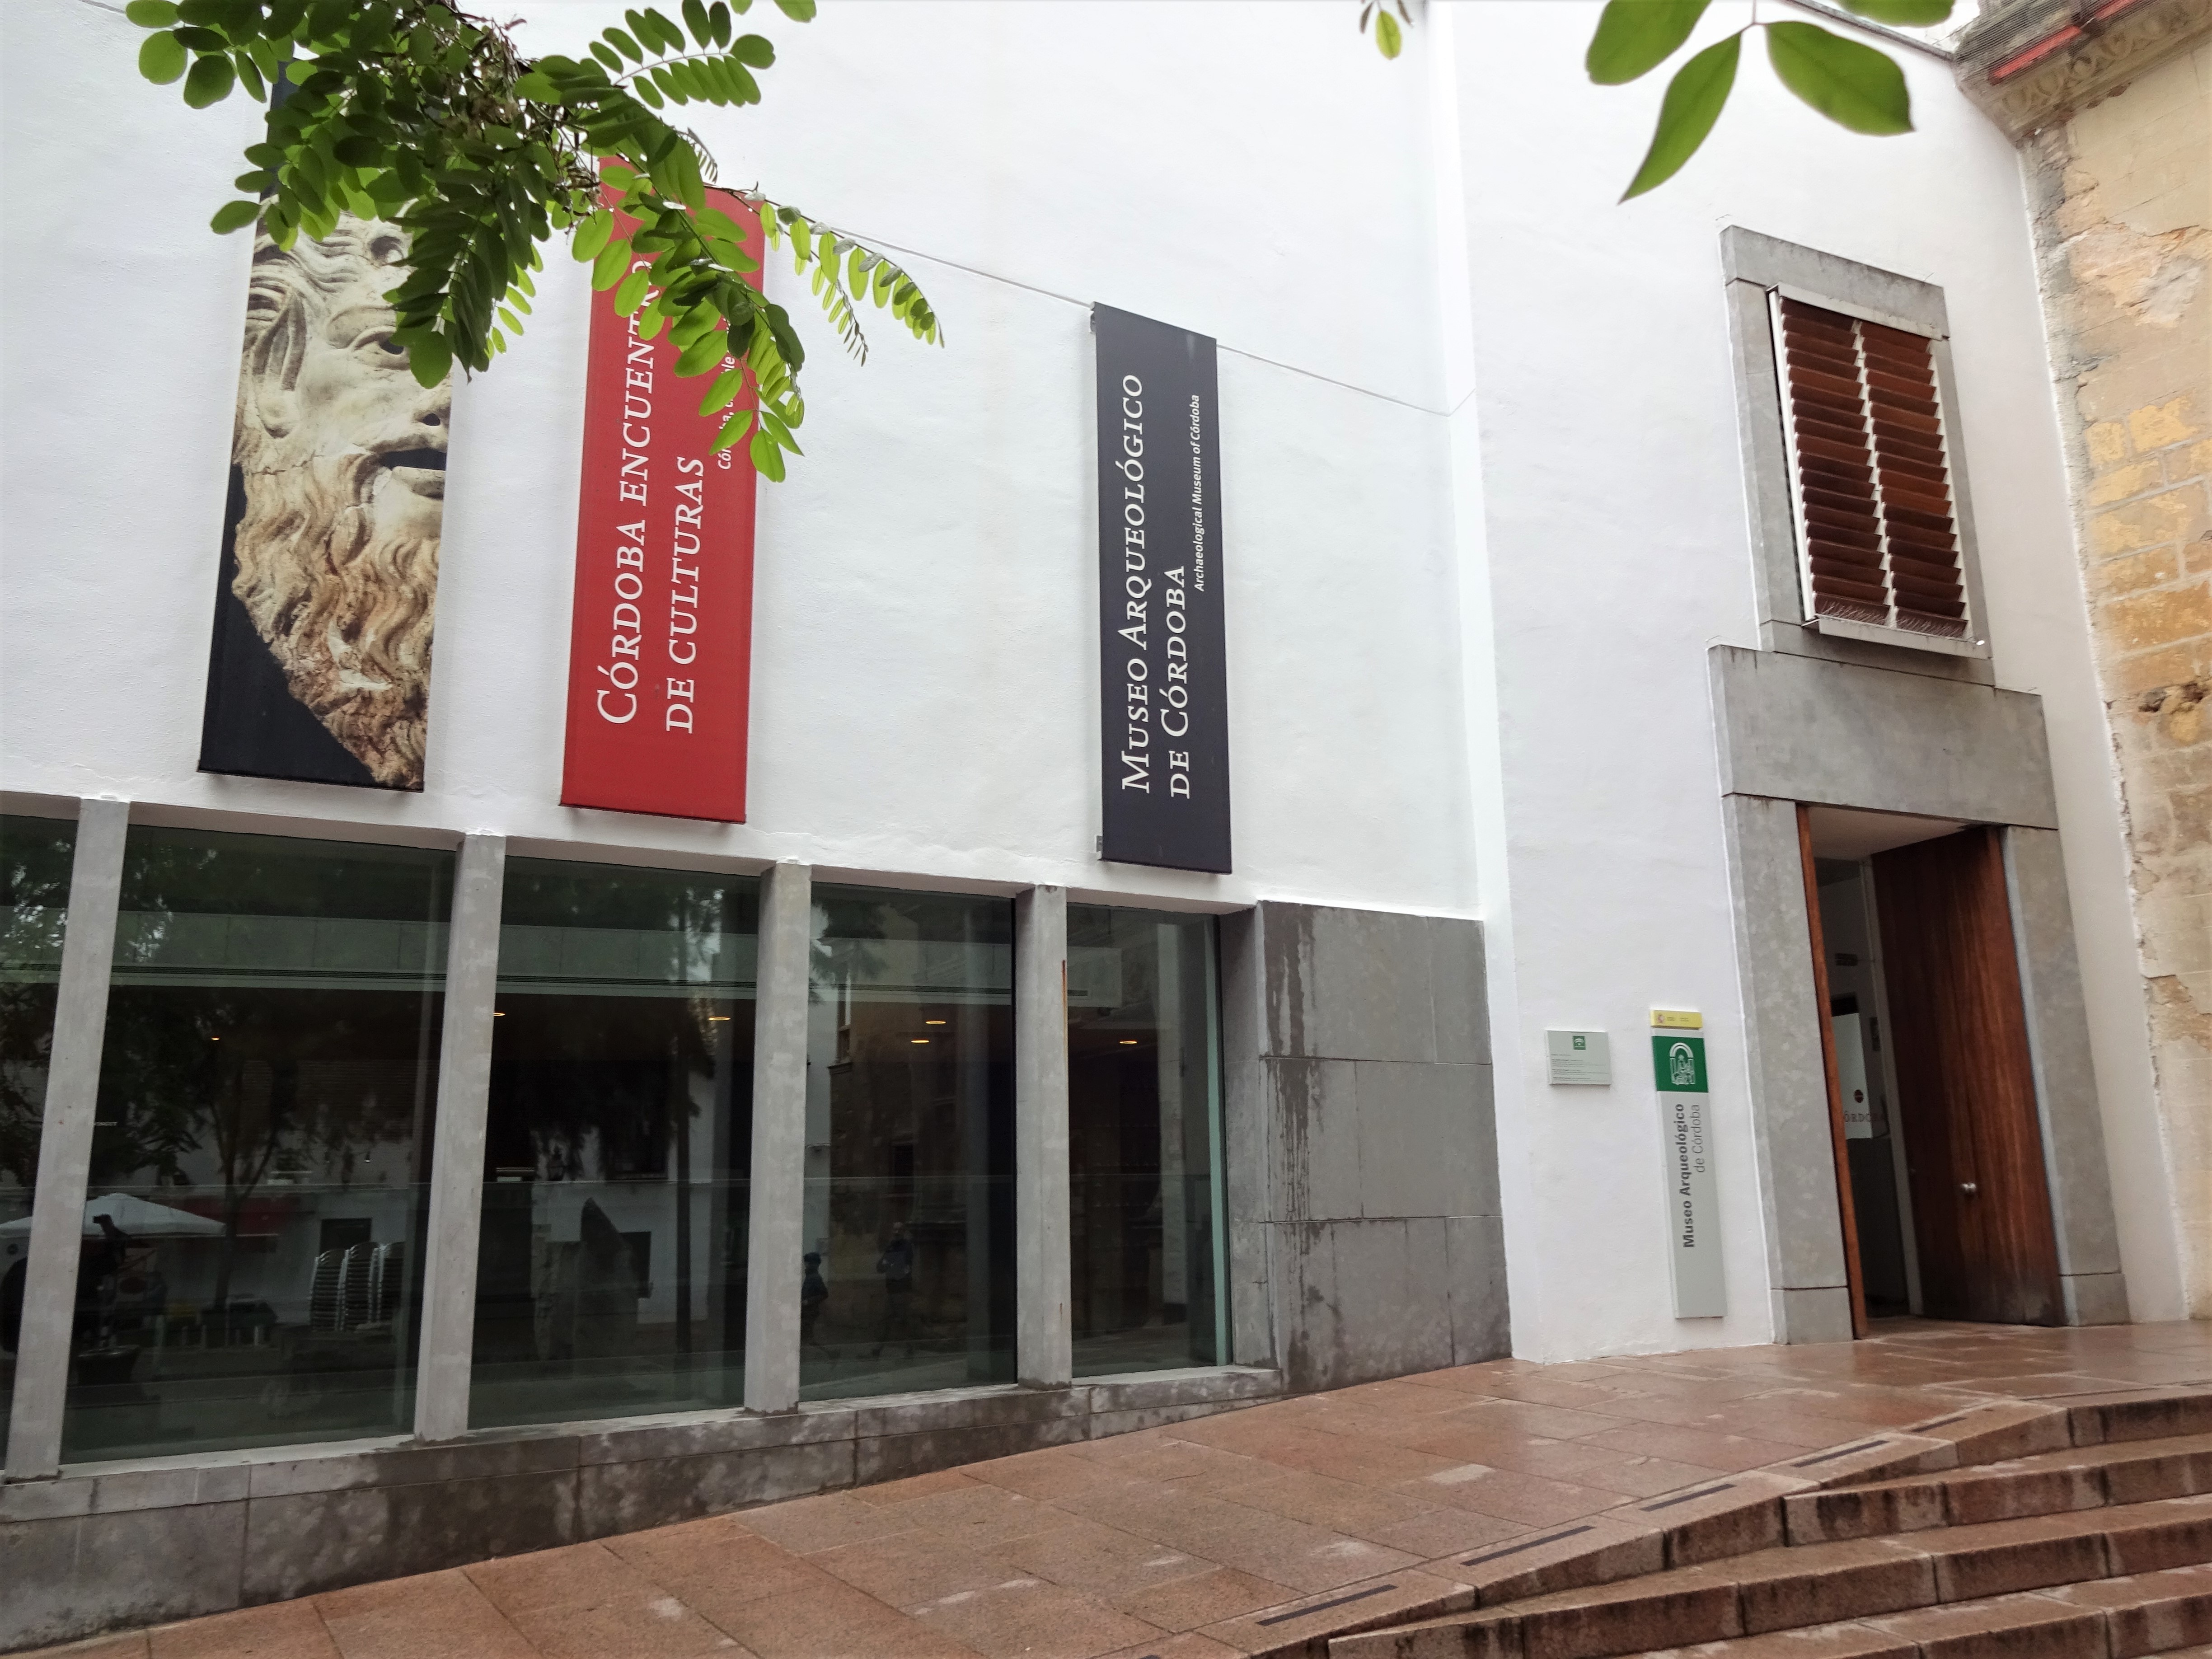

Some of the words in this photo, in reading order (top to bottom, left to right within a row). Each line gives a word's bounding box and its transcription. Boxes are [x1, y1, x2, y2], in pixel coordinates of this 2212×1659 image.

[1187, 394, 1200, 441] Córdoba
[1190, 441, 1200, 455] of
[1190, 455, 1202, 505] Museum
[1115, 375, 1152, 651] ARQUEOLÓGICO
[669, 456, 704, 665] CULTURAS
[1191, 507, 1205, 592] Archaeological
[597, 520, 646, 724] CÓRDOBA
[1159, 566, 1189, 737] CÓRDOBA
[665, 678, 695, 734] DE
[1121, 658, 1150, 794] MUSEO
[1169, 750, 1190, 799] DE
[1673, 1104, 1692, 1196] Arqueológico
[1690, 1105, 1703, 1154] Córdoba
[1693, 1158, 1705, 1173] de
[1682, 1200, 1695, 1248] Museo
